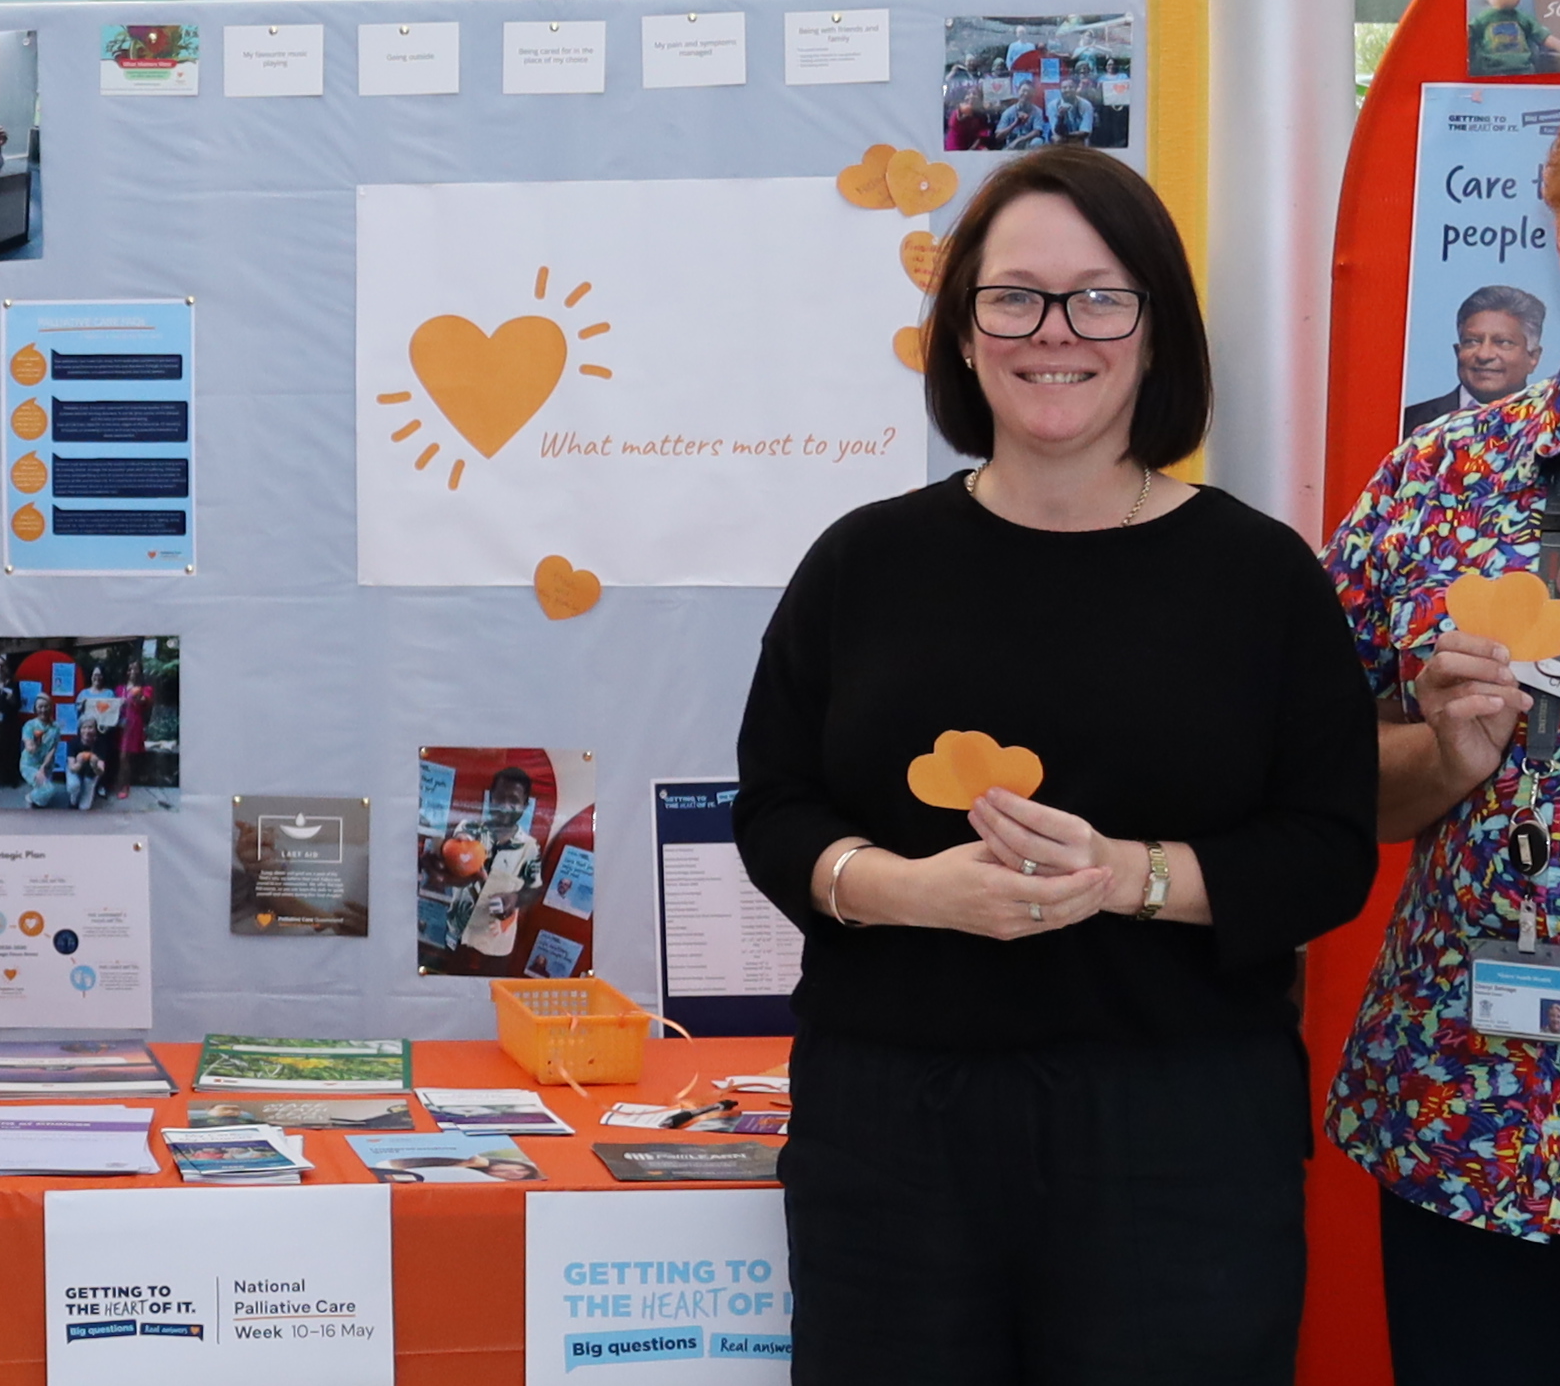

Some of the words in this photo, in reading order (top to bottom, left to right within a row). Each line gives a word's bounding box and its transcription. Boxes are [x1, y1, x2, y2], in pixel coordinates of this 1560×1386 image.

[1448, 115, 1491, 123] GETTING
[1493, 115, 1507, 123] TO
[1448, 123, 1467, 131] THE
[1492, 124, 1505, 132] OF
[1445, 165, 1517, 204] Care
[1441, 215, 1546, 264] people
[540, 430, 613, 458] What
[621, 433, 724, 457] matters
[732, 433, 793, 456] most
[802, 433, 828, 456] to
[832, 427, 896, 463] you?
[25, 850, 46, 859] Plan
[563, 1260, 716, 1286] GETTING
[725, 1259, 772, 1283] TO
[65, 1286, 143, 1300] GETTING
[147, 1285, 171, 1298] TO
[234, 1278, 306, 1294] National
[65, 1303, 100, 1316] THE
[104, 1299, 148, 1317] HEART
[149, 1301, 172, 1314] OF
[177, 1301, 196, 1314] IT.
[234, 1300, 311, 1316] Palliative
[315, 1299, 356, 1314] Care
[563, 1294, 632, 1318] THE
[641, 1287, 728, 1321] HEART
[727, 1292, 774, 1316] OF
[70, 1326, 86, 1338] Big
[88, 1323, 135, 1336] questions
[144, 1325, 160, 1334] Real
[161, 1325, 188, 1335] answers
[234, 1324, 283, 1340] Week
[341, 1323, 375, 1341] May
[572, 1341, 603, 1358] Big
[608, 1336, 697, 1357] questions
[720, 1337, 748, 1354] Real
[752, 1340, 793, 1355] answe
